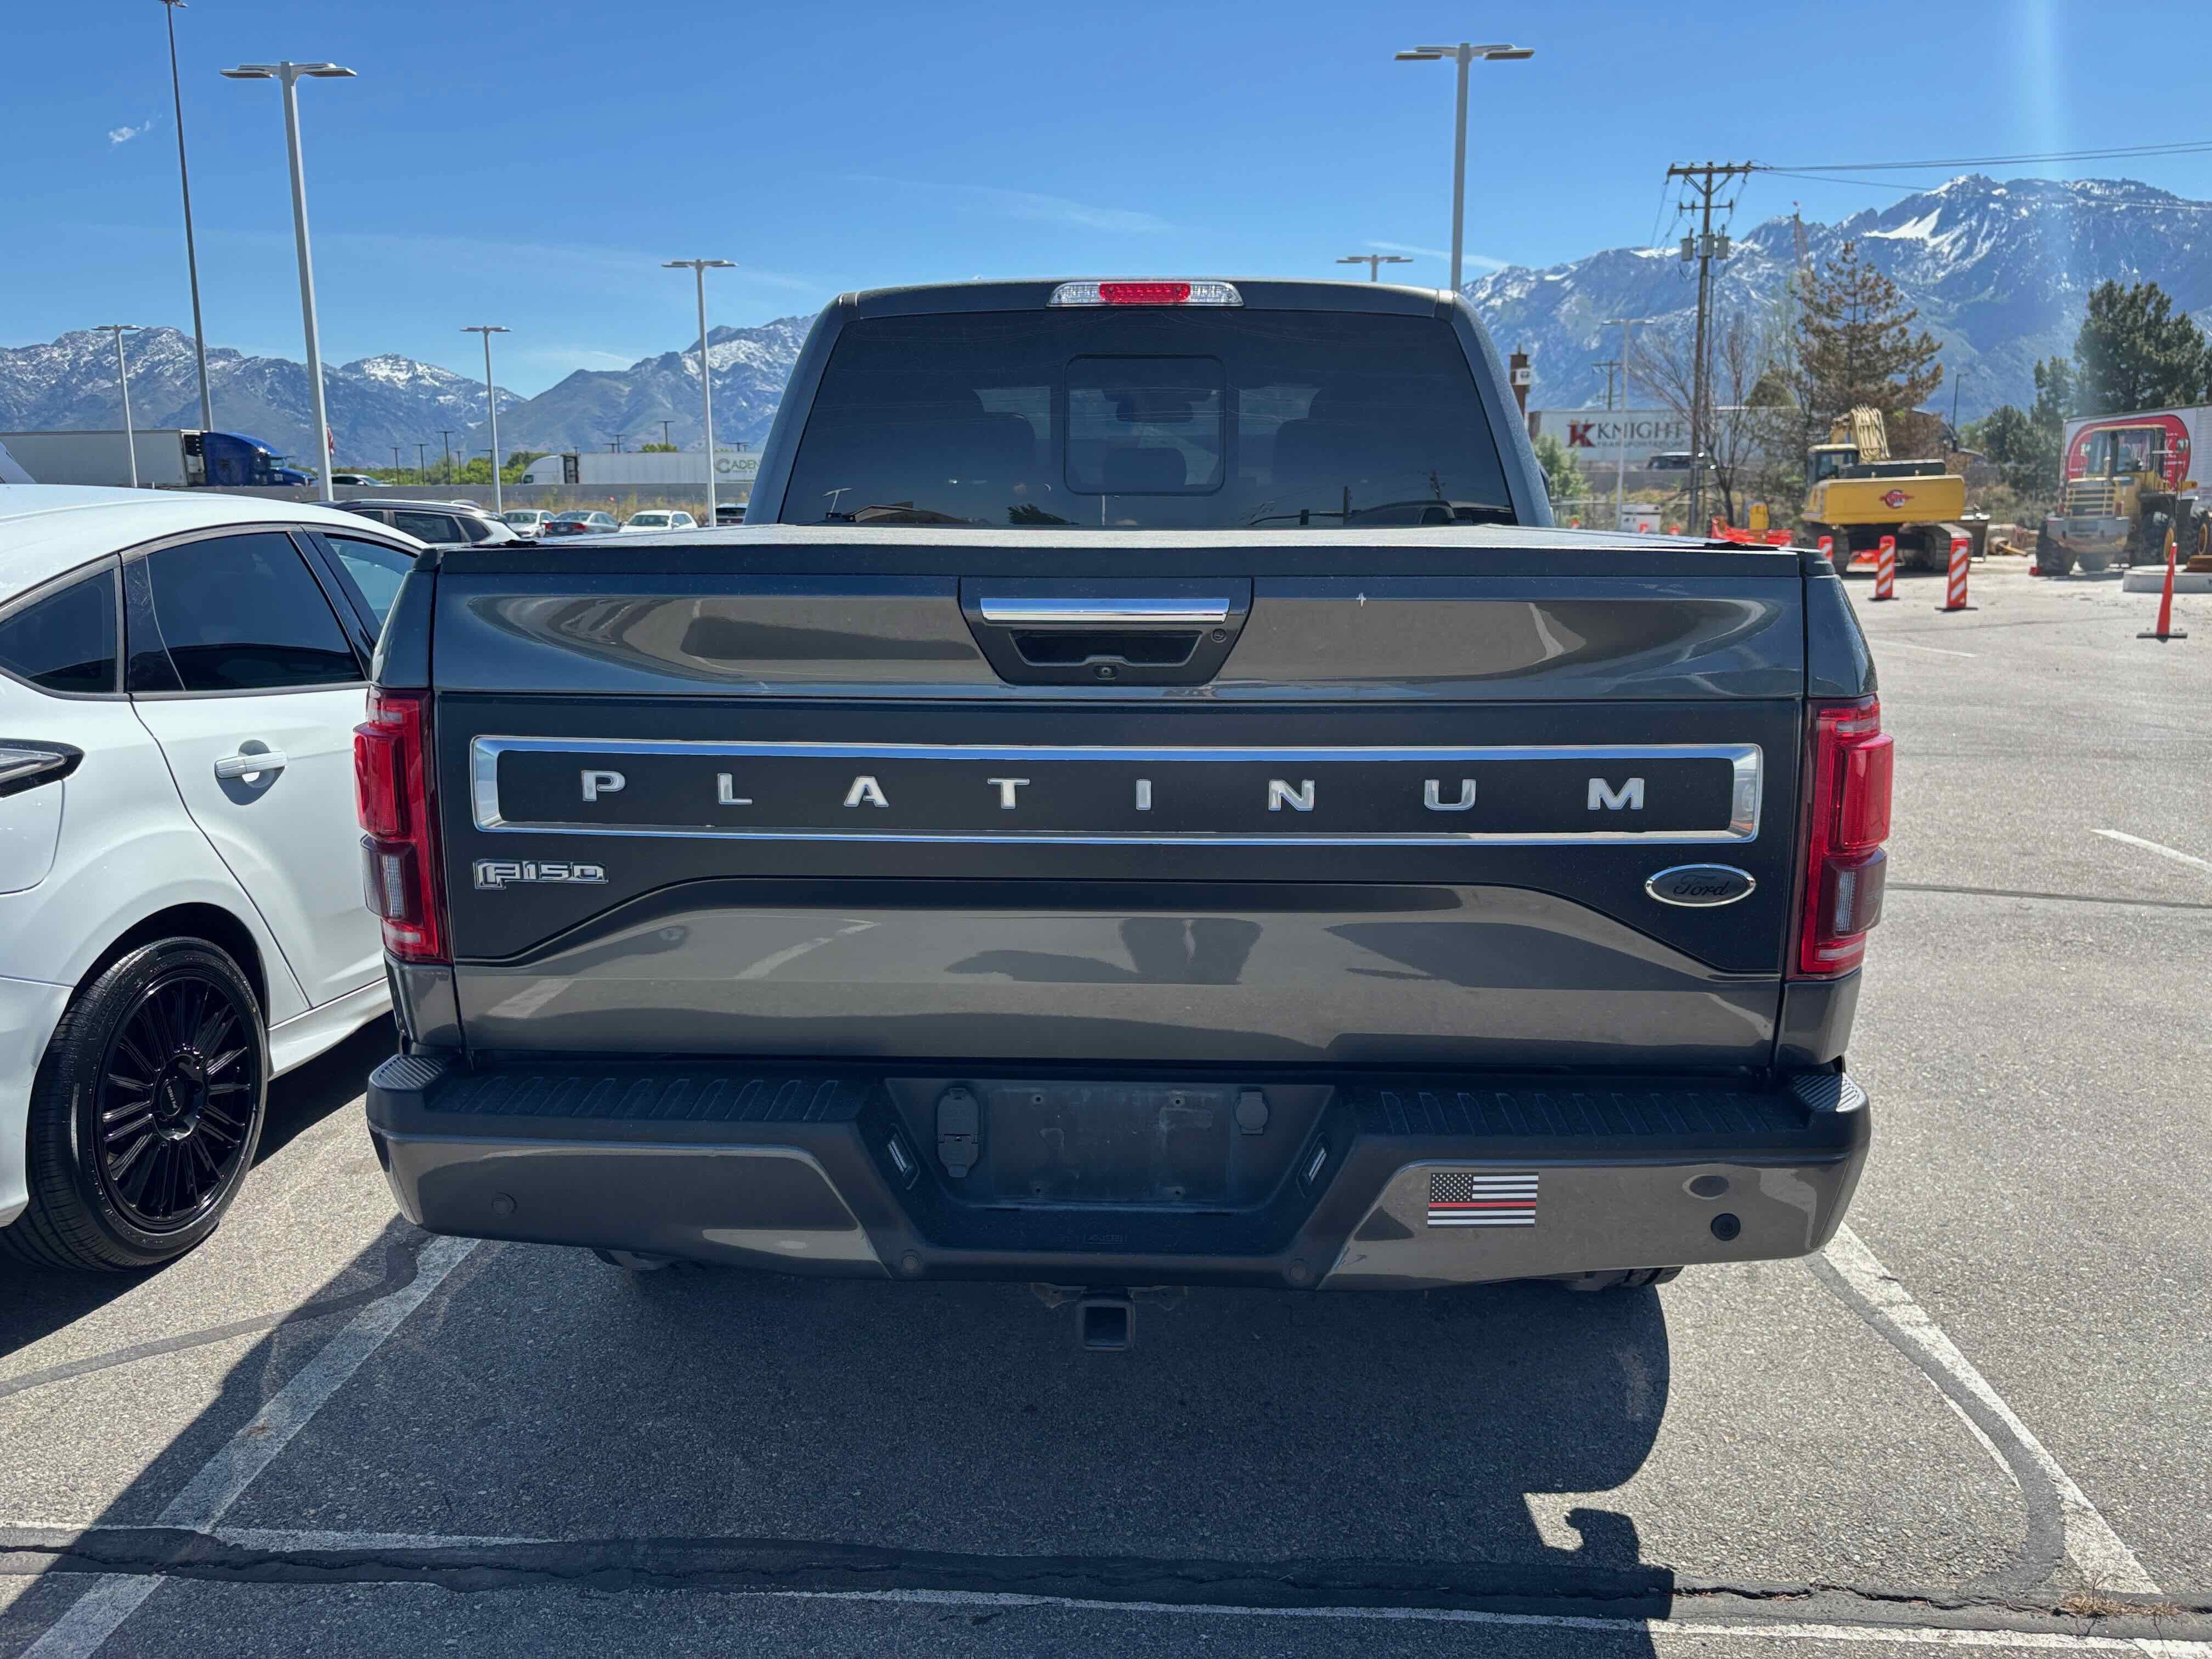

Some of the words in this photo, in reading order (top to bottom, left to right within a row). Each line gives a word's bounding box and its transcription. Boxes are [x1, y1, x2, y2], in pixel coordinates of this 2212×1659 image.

[1597, 421, 1687, 439] KNIGHT
[582, 770, 1645, 811] PLATINUM
[1673, 875, 1730, 896] Ford
